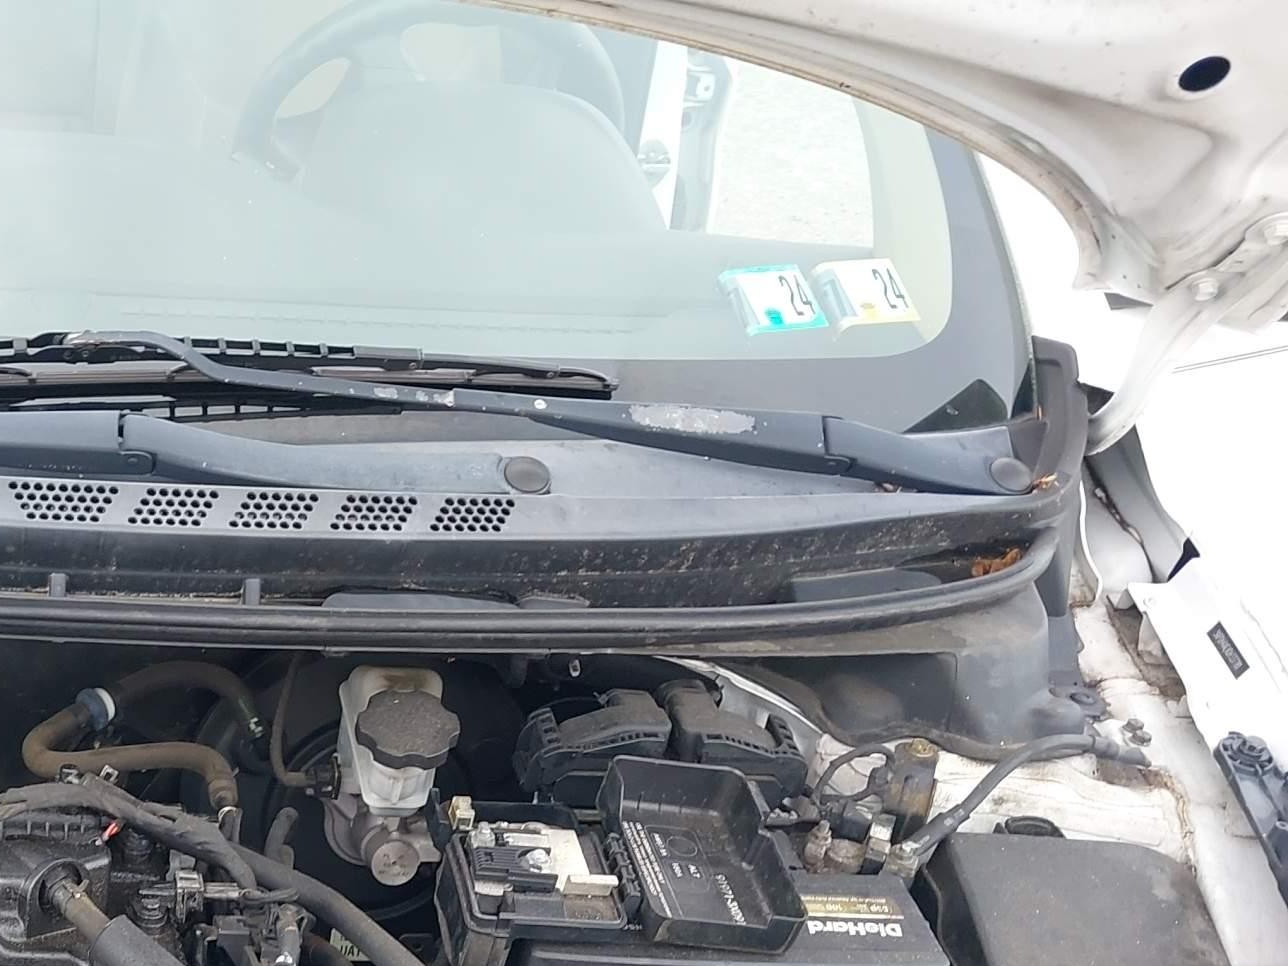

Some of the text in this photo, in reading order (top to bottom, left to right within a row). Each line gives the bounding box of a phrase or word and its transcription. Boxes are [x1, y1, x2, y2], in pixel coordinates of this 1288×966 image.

[778, 274, 816, 317] 24
[871, 267, 909, 310] 24
[807, 920, 903, 937] DieHard
